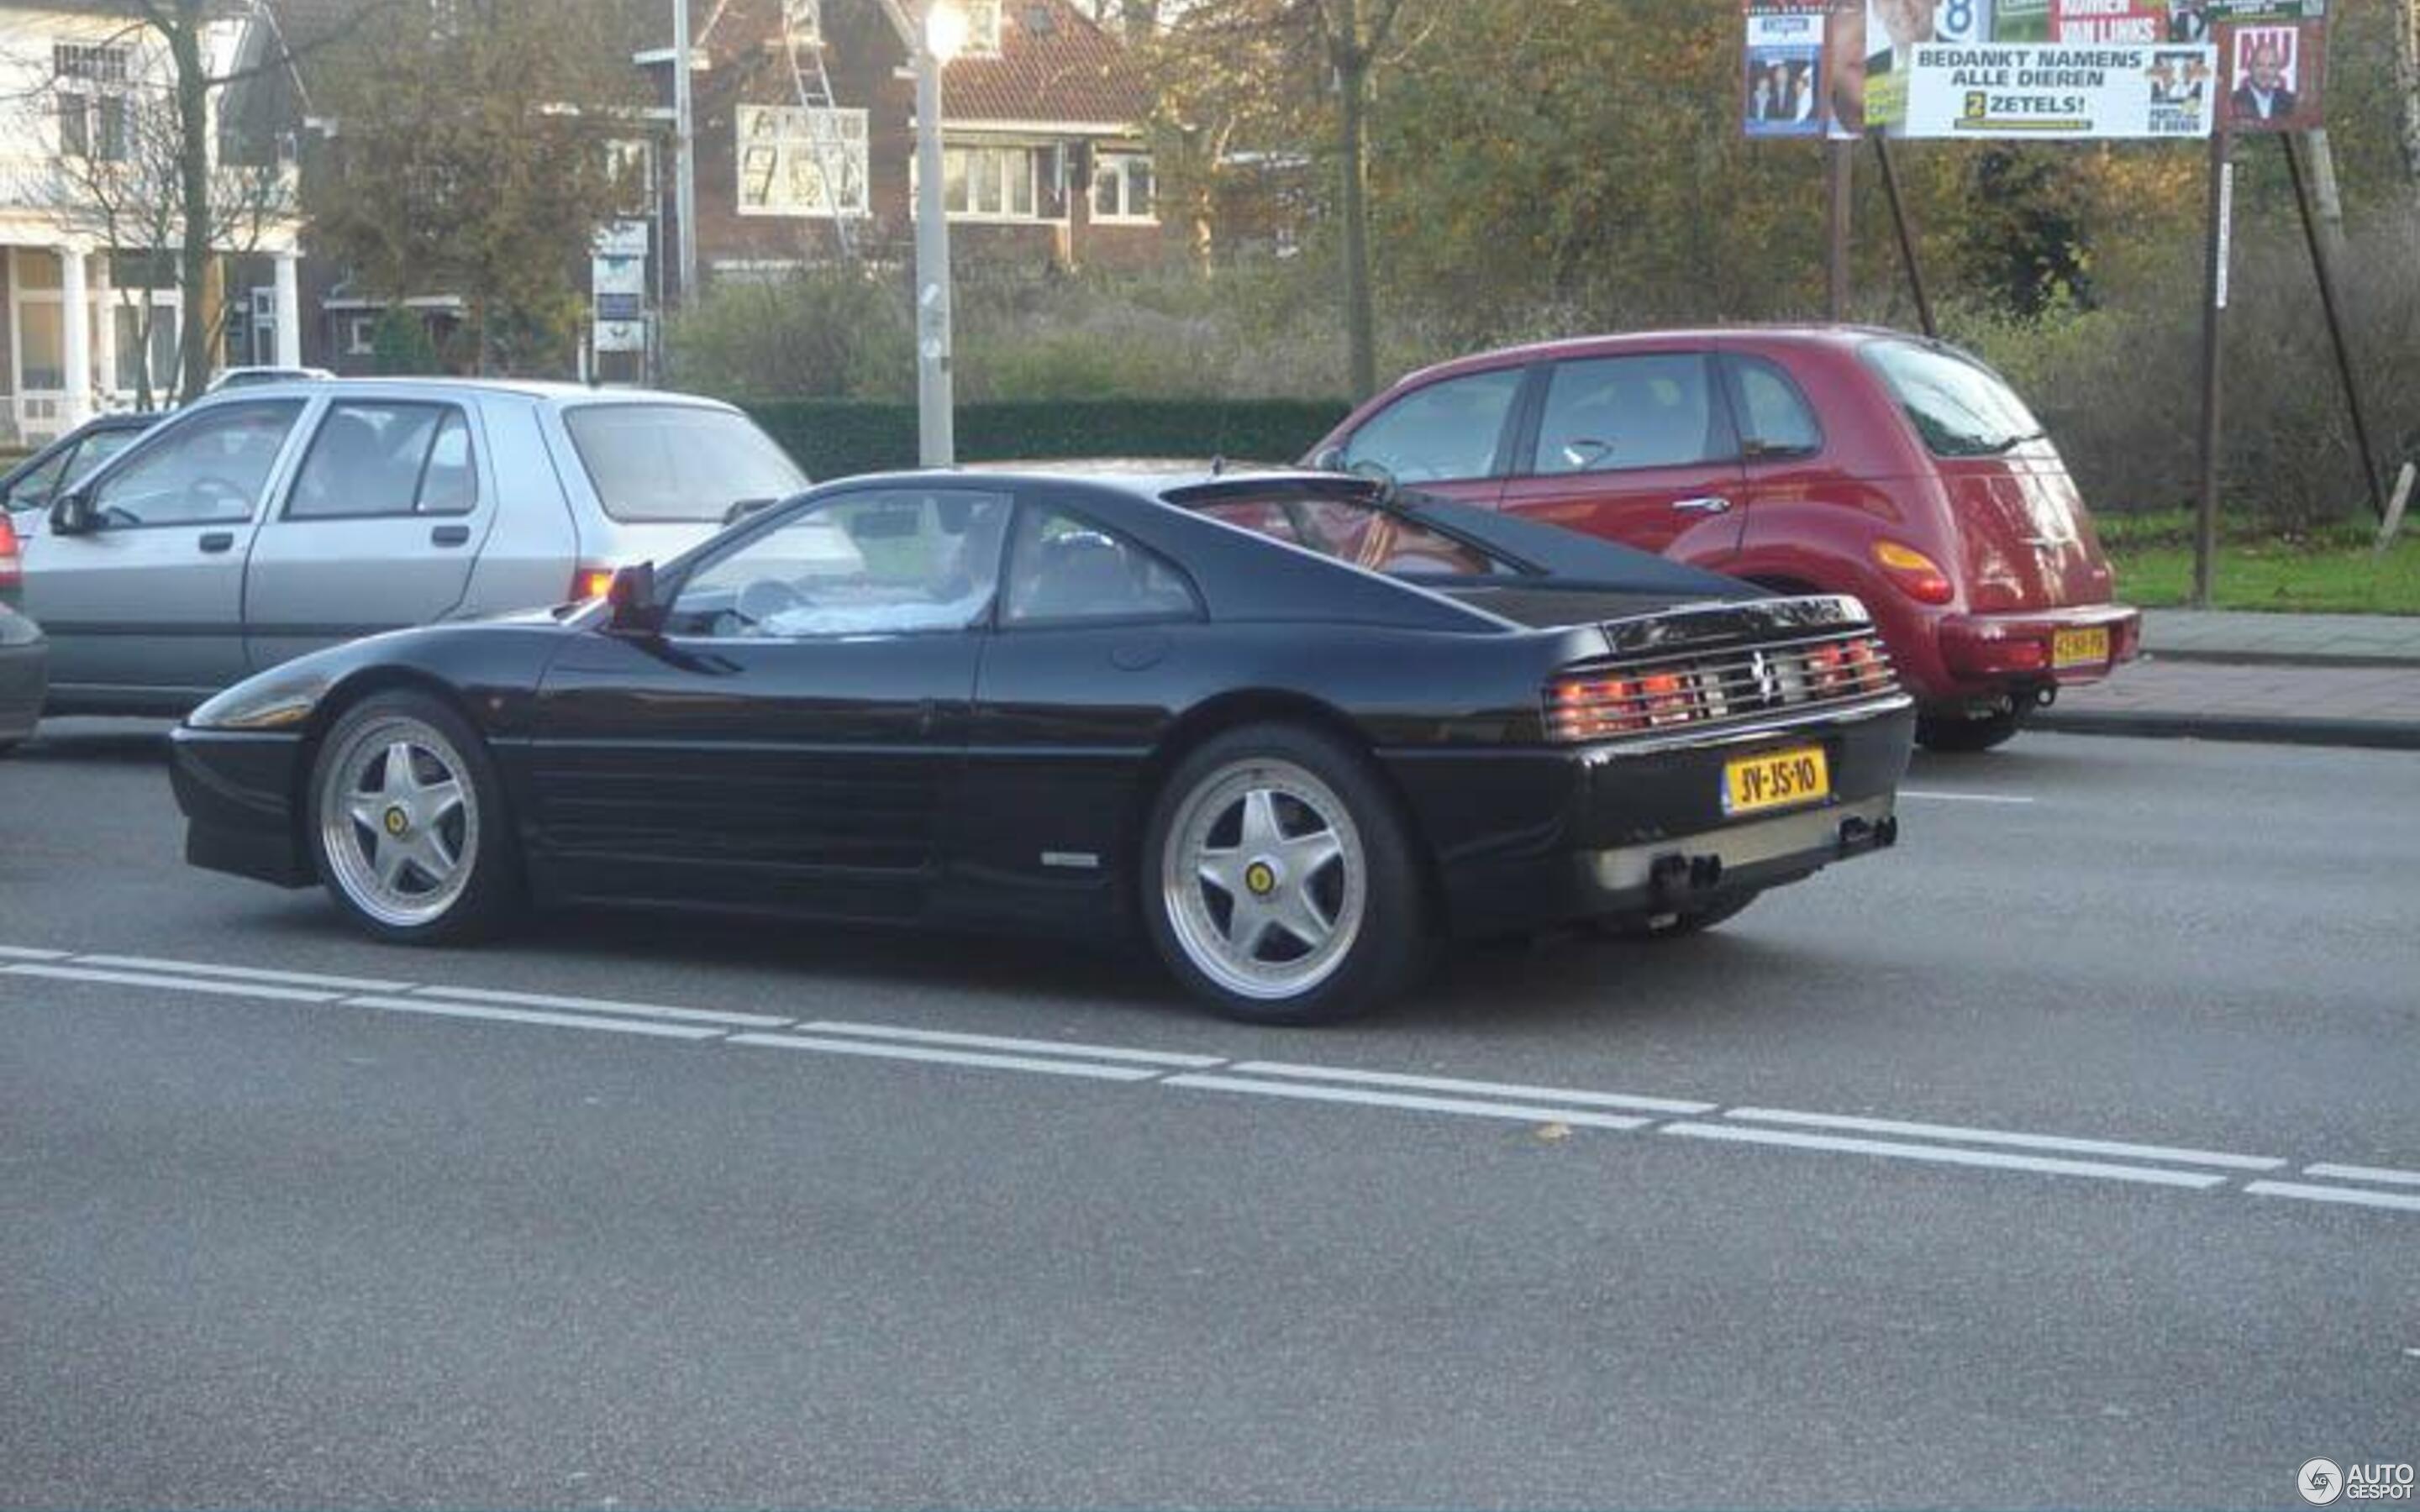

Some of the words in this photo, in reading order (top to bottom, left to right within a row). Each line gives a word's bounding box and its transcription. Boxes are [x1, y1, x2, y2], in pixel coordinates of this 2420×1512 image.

[1918, 50, 2031, 67] BEDANKT
[2038, 50, 2143, 68] NAMENS
[1951, 70, 2009, 87] ALLE
[2017, 69, 2106, 87] DIEREN
[1967, 92, 1986, 118] 2
[1990, 96, 2086, 113] ZETELS!
[1741, 757, 1817, 802] JV-JS-10
